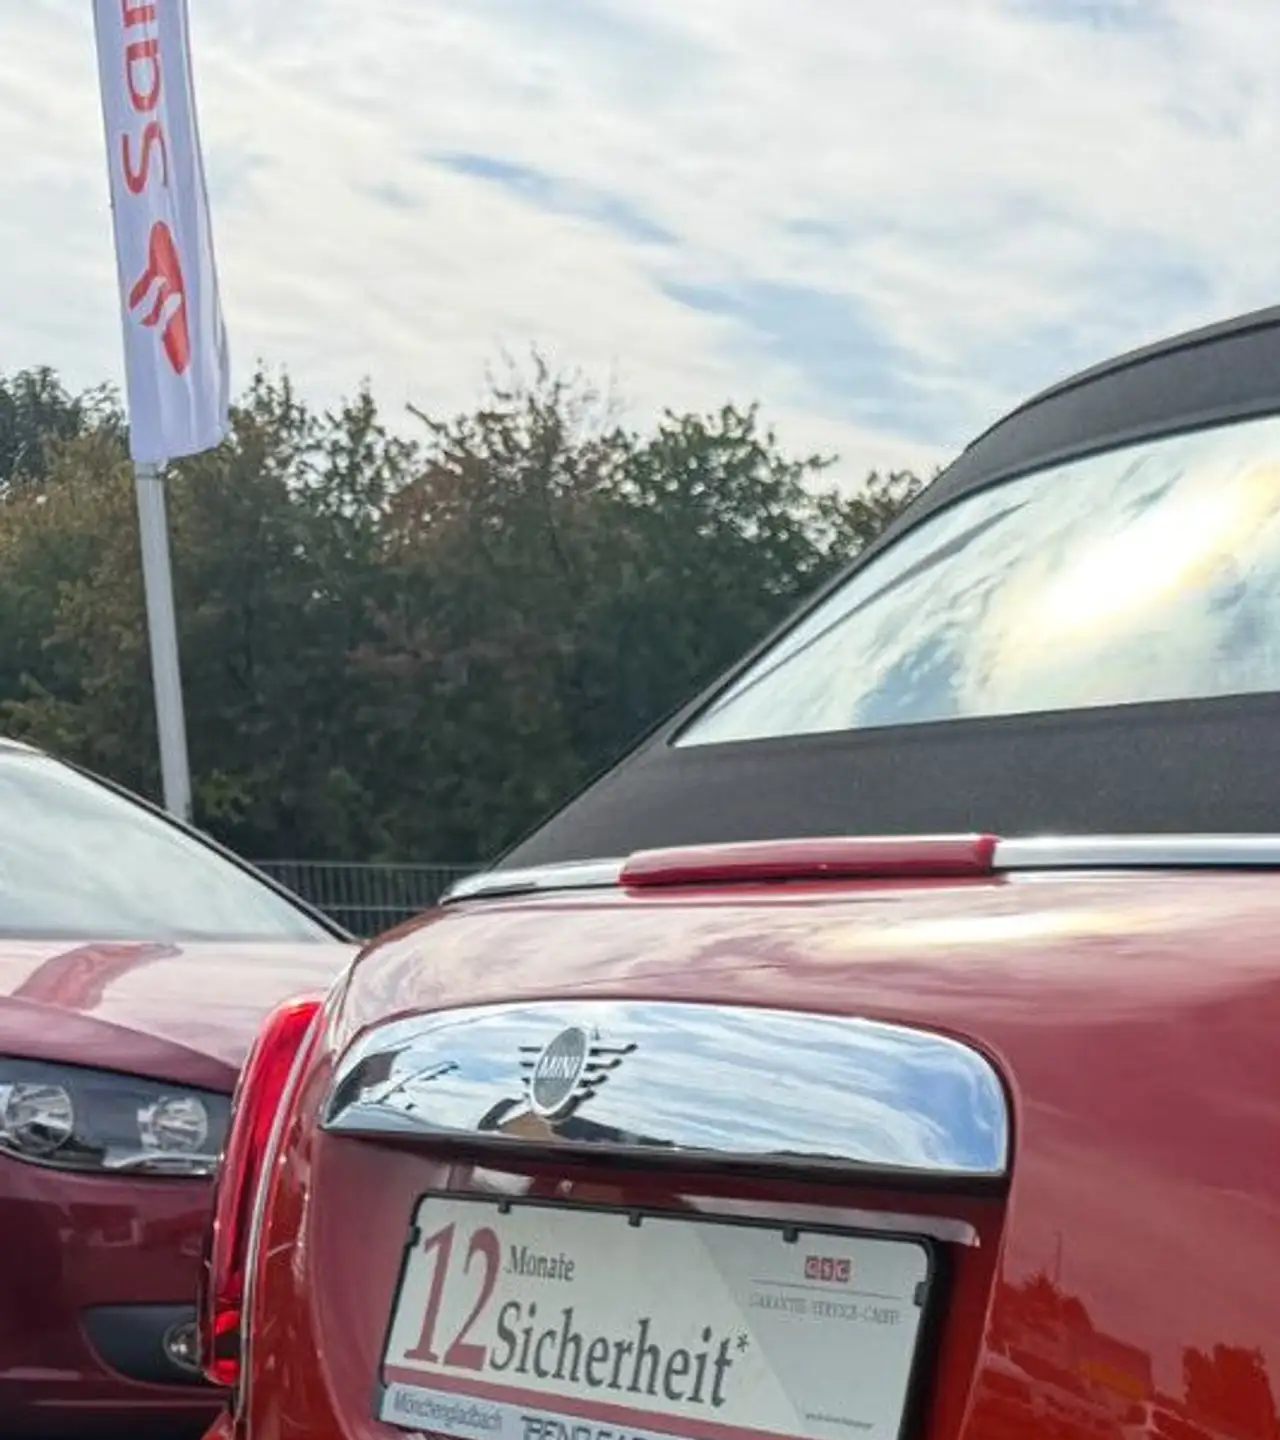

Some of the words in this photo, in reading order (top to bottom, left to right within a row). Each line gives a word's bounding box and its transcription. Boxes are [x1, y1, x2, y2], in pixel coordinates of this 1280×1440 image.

[540, 1054, 582, 1080] MINI
[403, 1220, 501, 1372] 12
[504, 1244, 576, 1283] Monate
